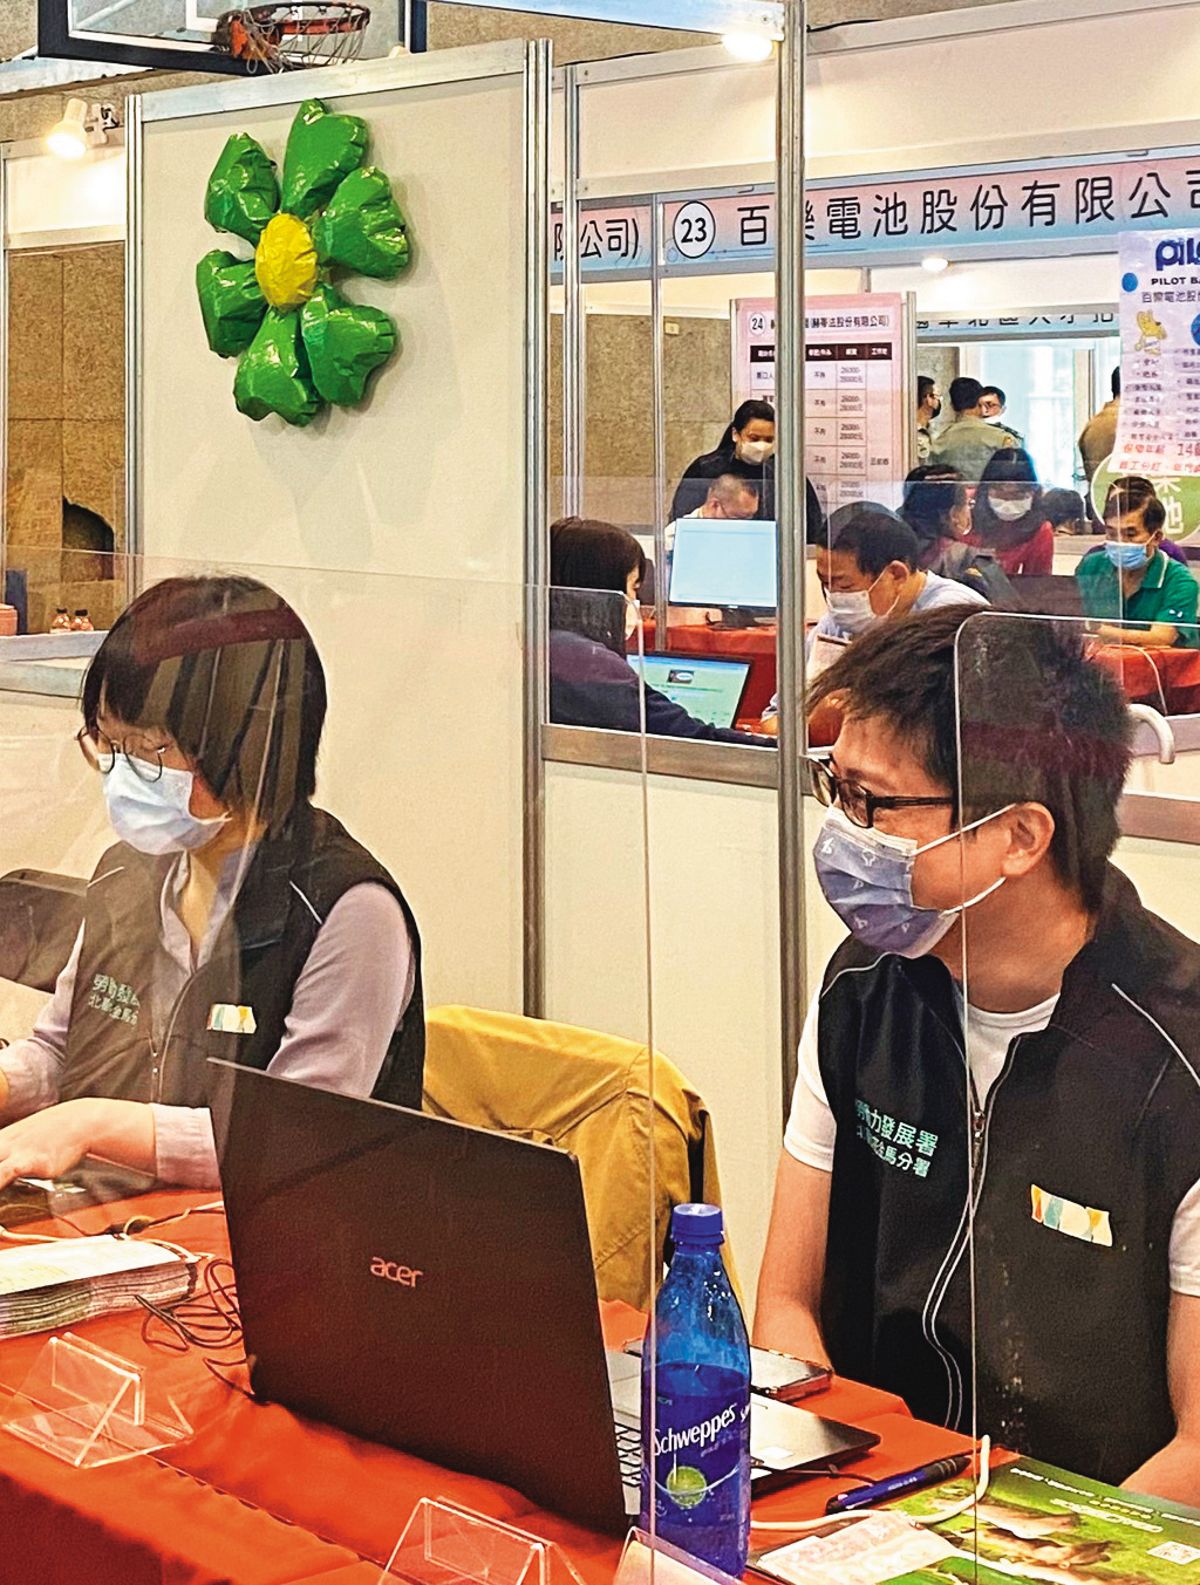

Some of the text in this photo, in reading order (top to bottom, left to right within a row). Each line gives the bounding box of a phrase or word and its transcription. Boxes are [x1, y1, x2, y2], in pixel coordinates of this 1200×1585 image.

[680, 217, 708, 244] 23
[1155, 237, 1200, 272] pil
[1151, 276, 1187, 286] PILOT
[1141, 290, 1200, 304] 百樂電池股
[751, 317, 764, 331] 24
[370, 1256, 424, 1288] acer
[654, 1402, 738, 1457] Schweppes
